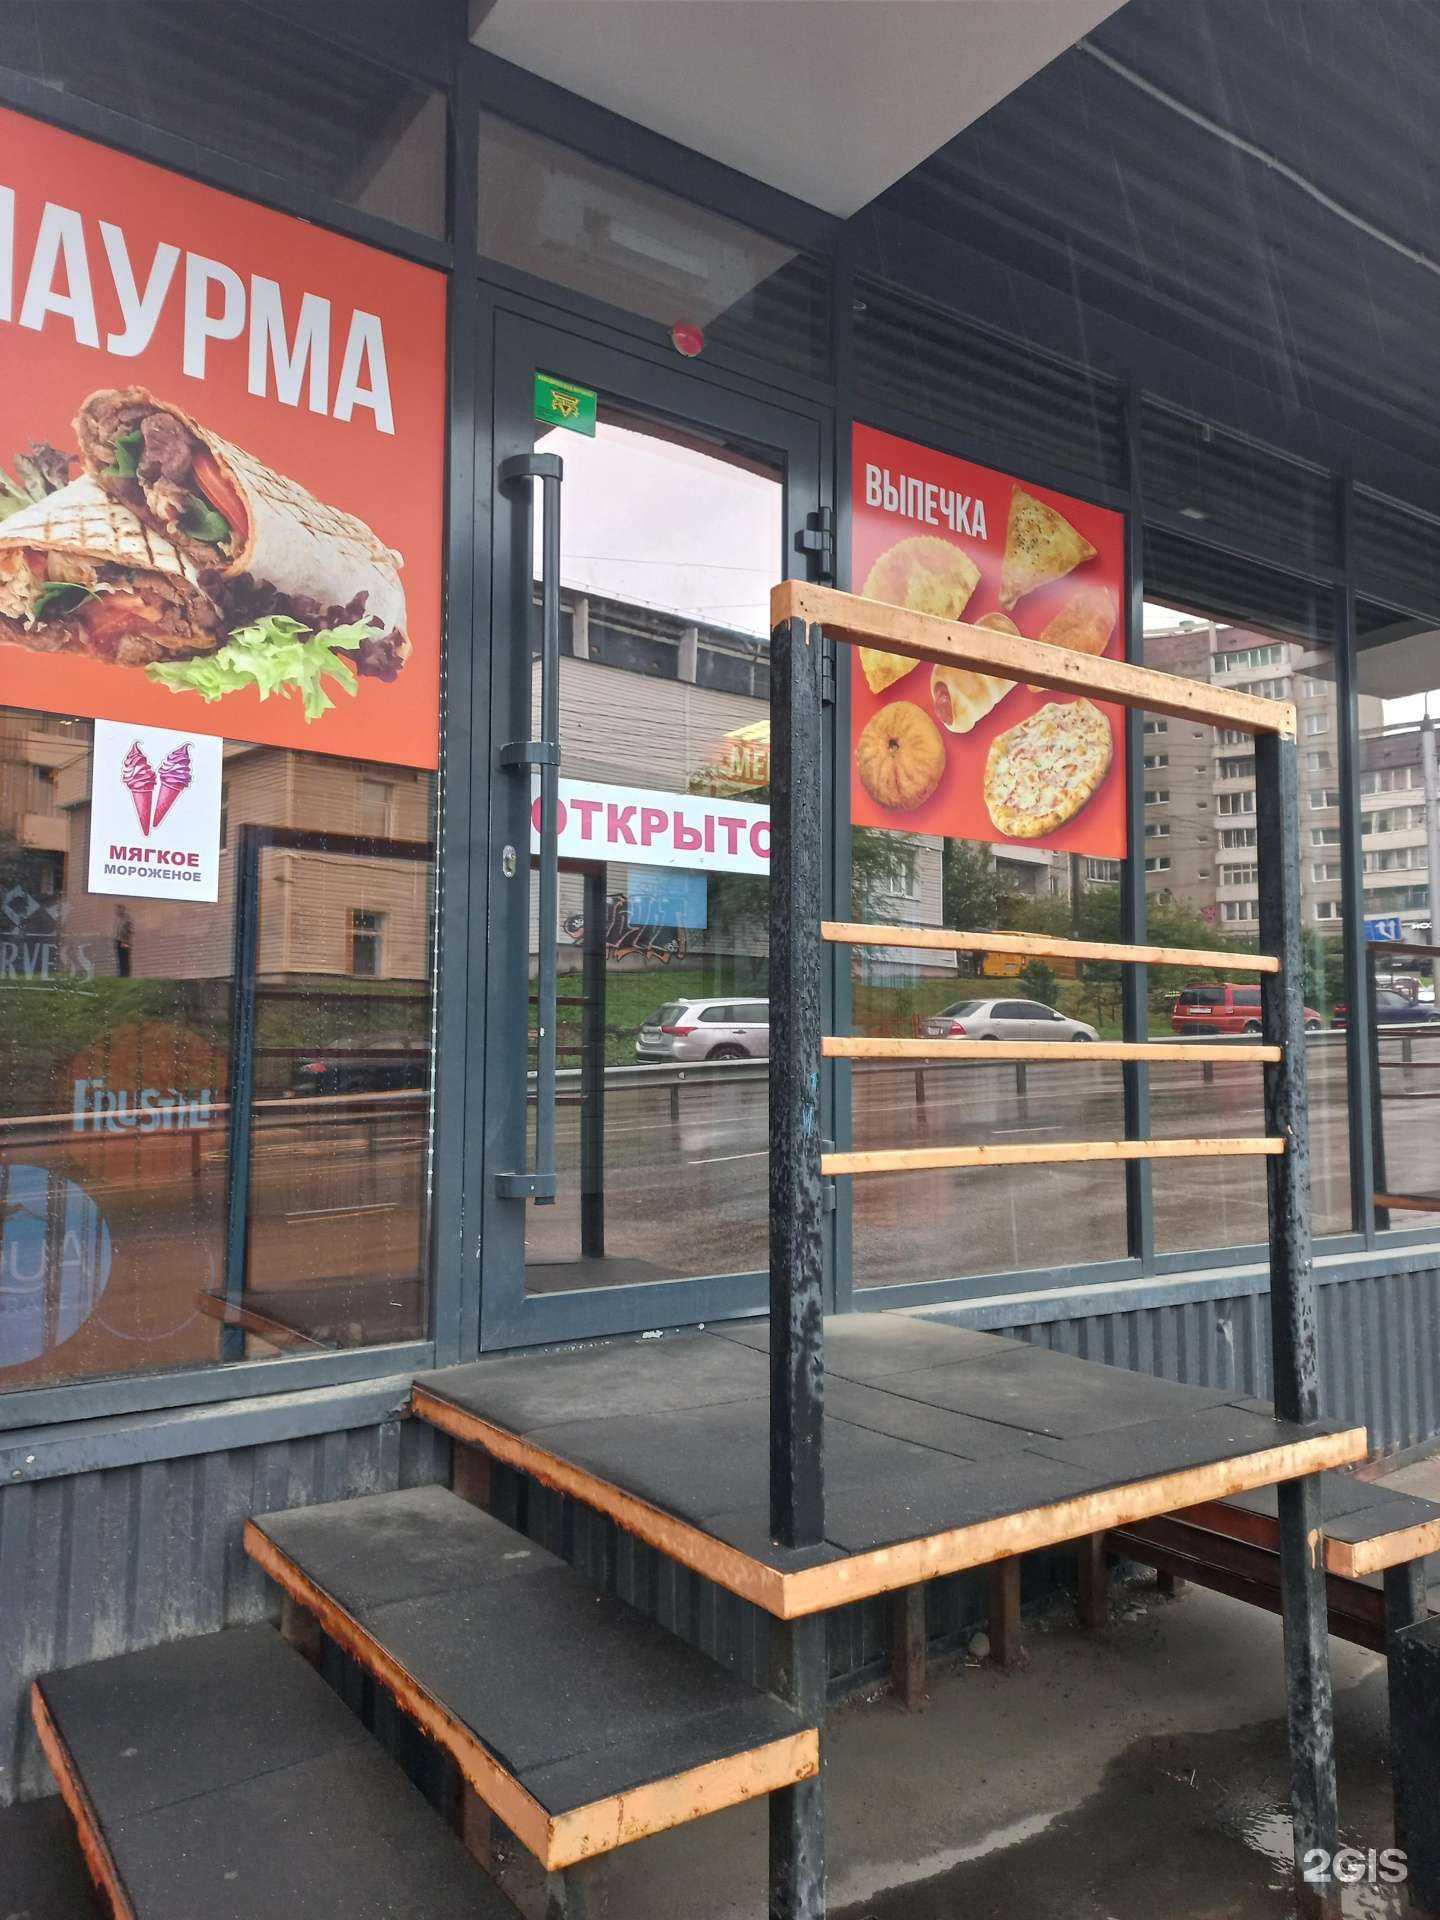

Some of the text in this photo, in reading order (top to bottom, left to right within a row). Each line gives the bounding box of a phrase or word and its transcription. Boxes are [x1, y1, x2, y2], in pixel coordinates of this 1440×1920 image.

[0, 185, 395, 436] АУРМА
[865, 463, 987, 541] ВЫПЕЧКА
[731, 745, 770, 783] МЕ
[104, 864, 202, 882] МОРОЖЕНОЕ
[109, 845, 200, 868] МЯГКОЕ
